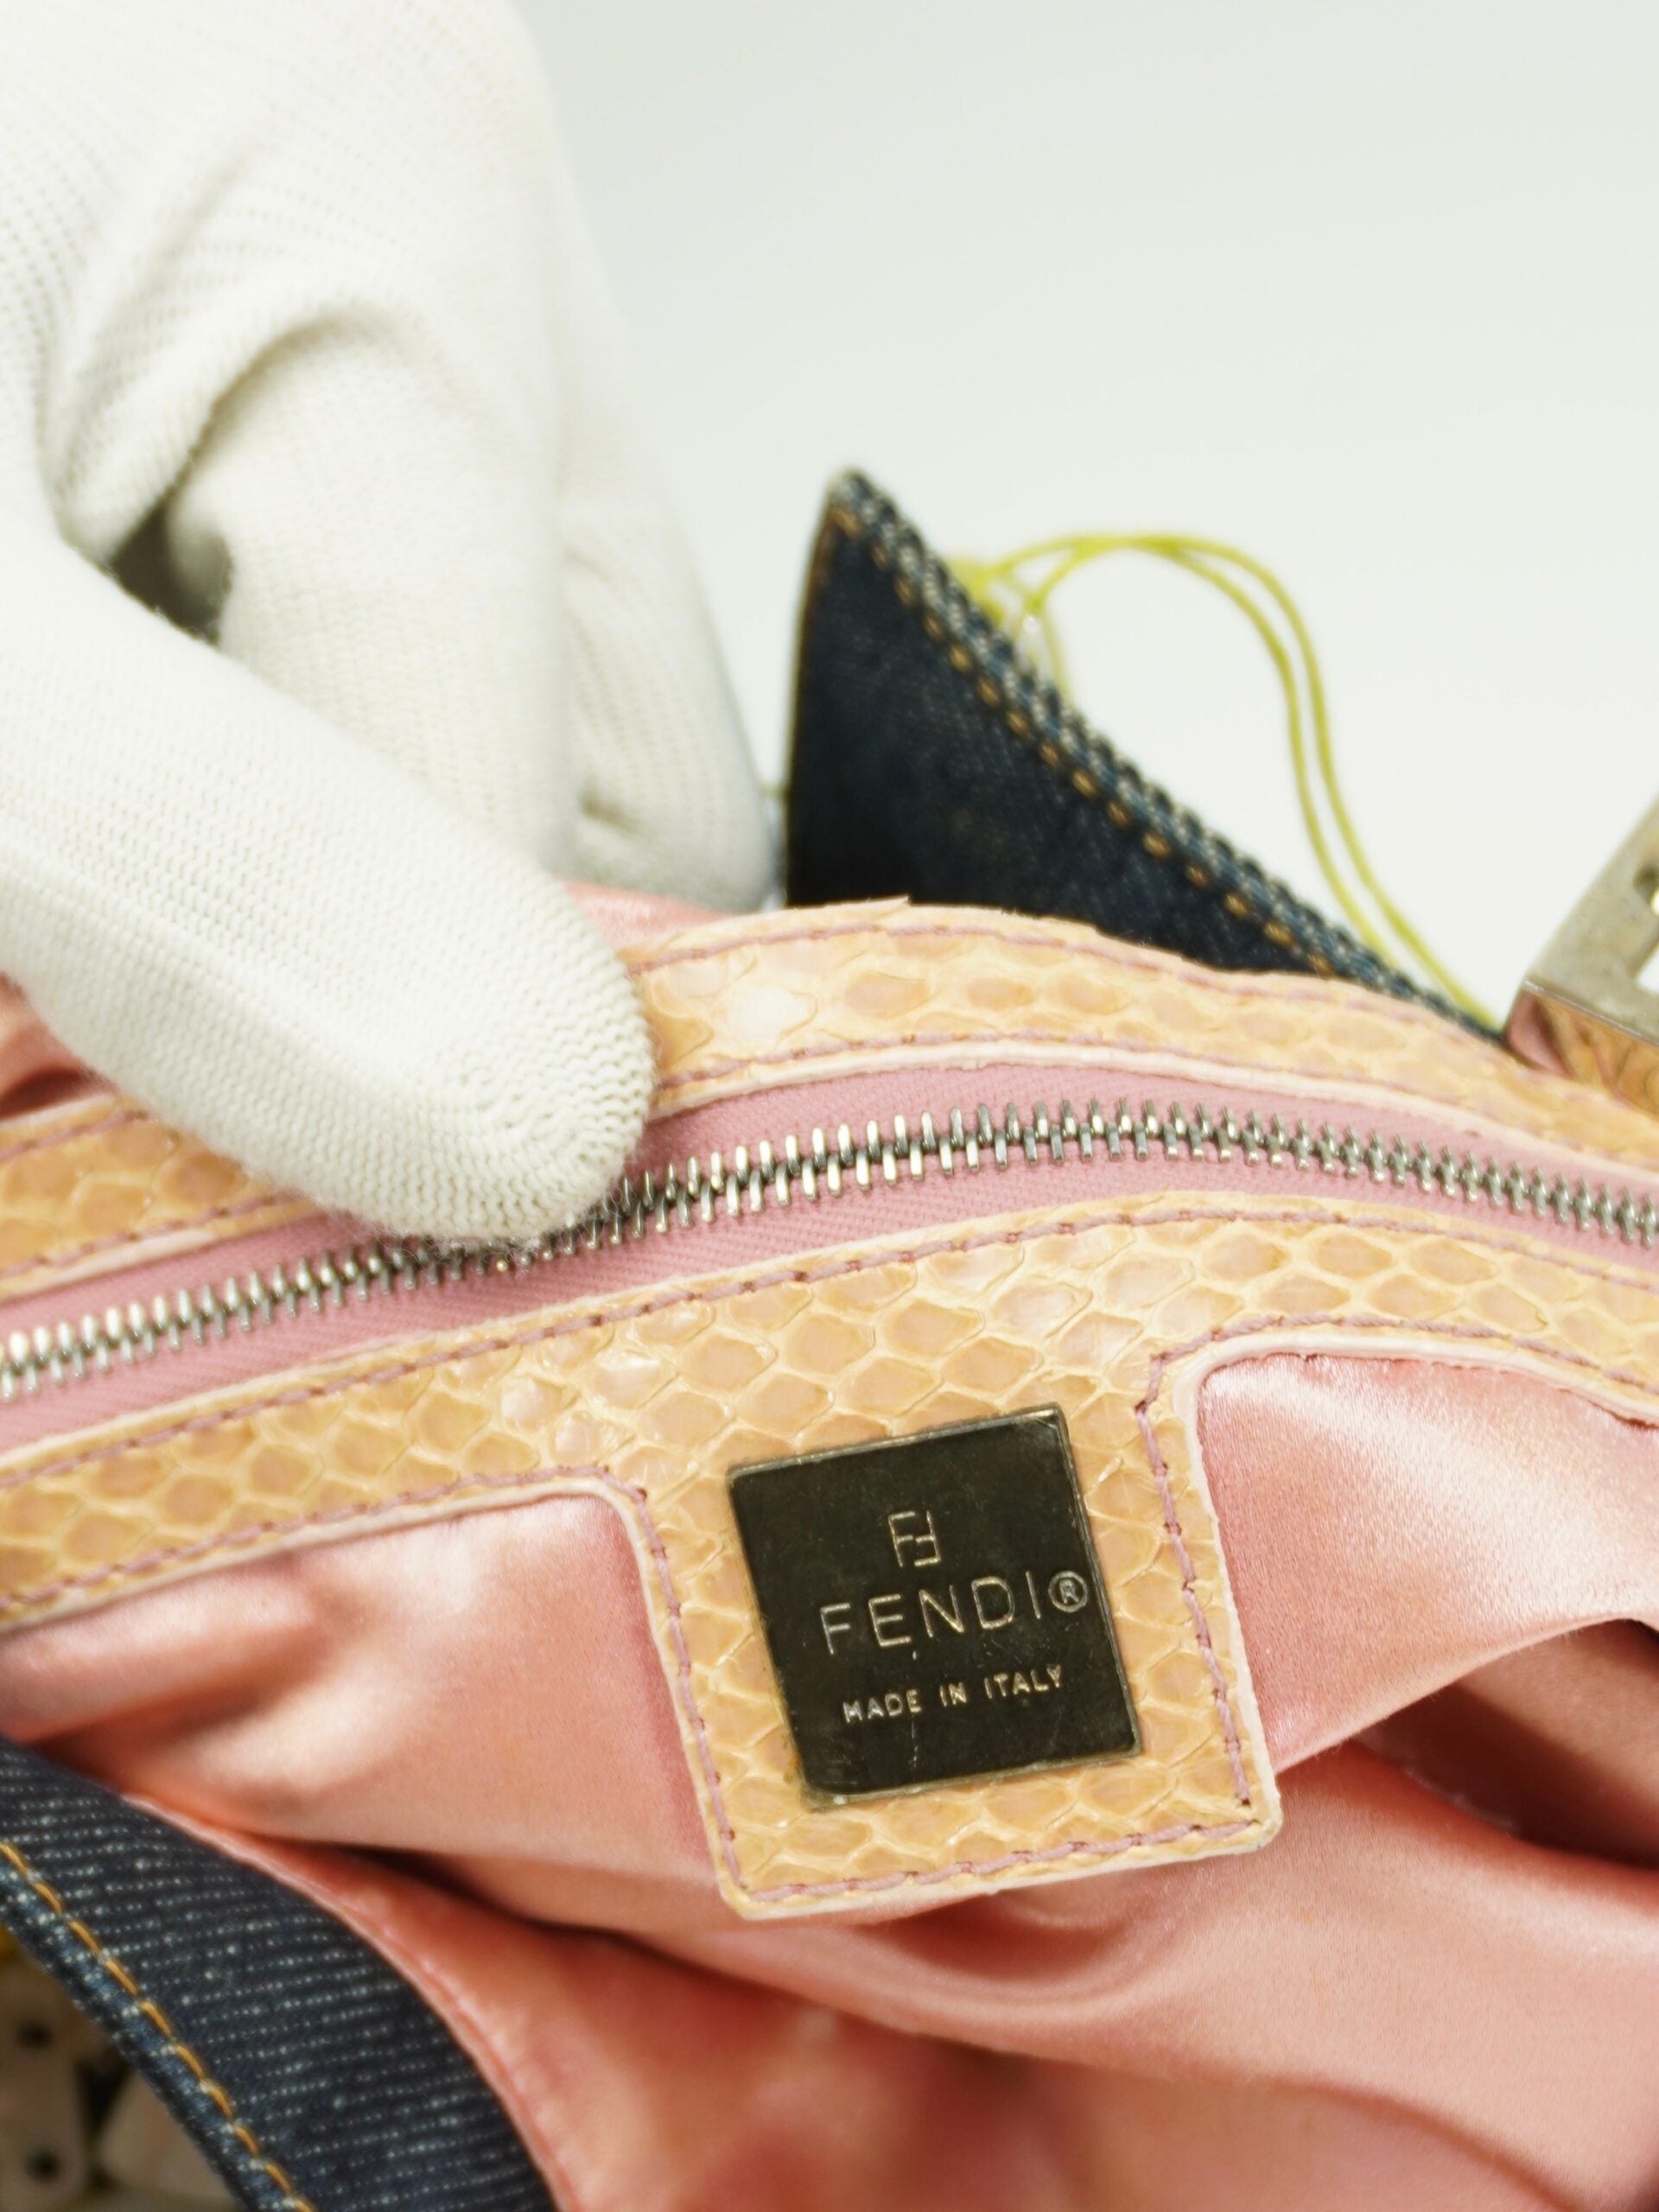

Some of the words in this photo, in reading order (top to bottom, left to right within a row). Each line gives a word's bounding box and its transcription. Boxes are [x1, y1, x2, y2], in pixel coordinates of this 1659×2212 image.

[842, 1688, 923, 1724] MADE
[938, 1682, 968, 1707] IN
[983, 1663, 1063, 1700] ITALY
